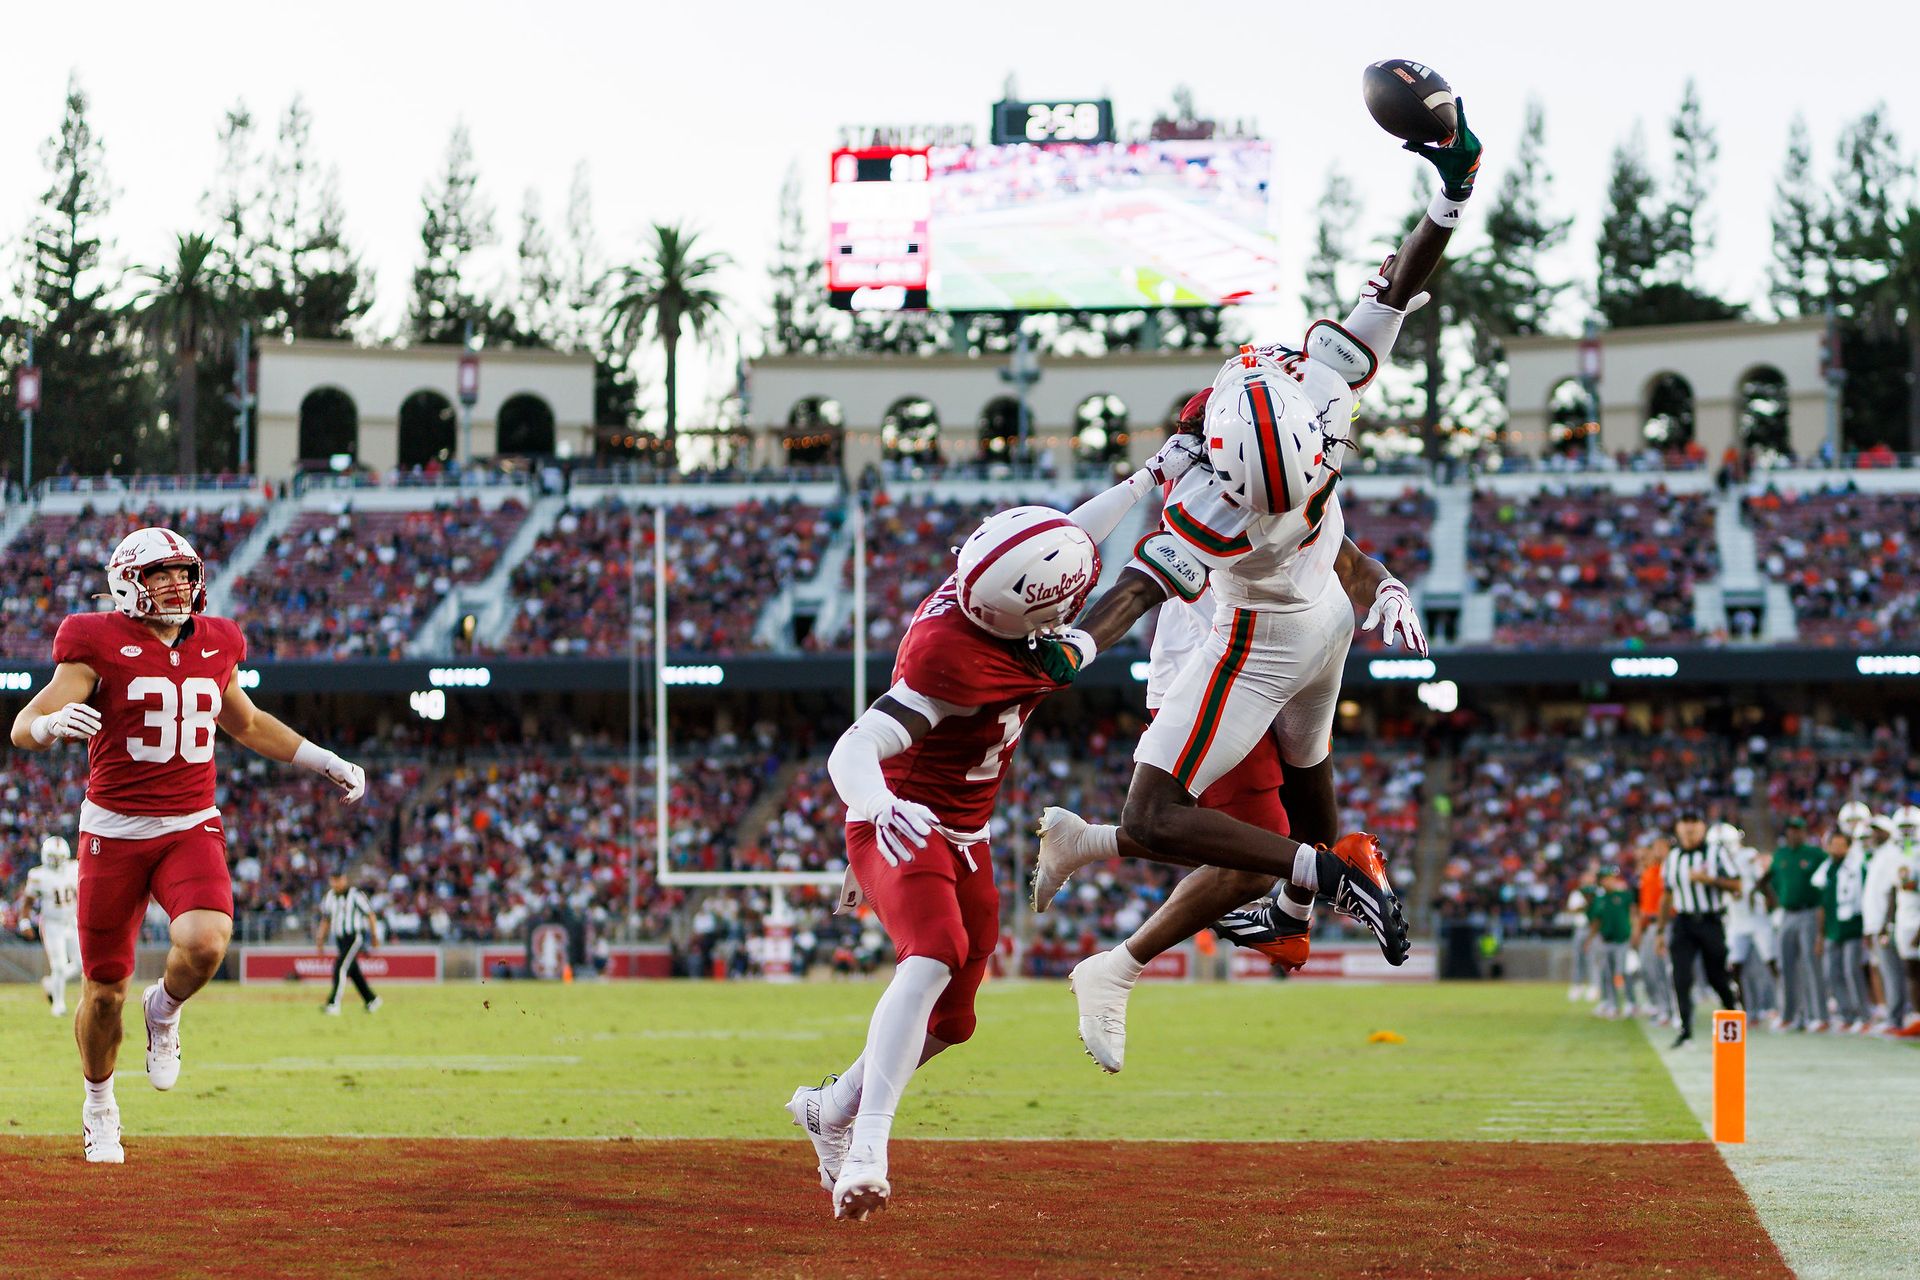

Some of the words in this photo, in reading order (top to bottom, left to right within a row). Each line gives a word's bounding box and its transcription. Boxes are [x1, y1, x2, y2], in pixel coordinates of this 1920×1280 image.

[836, 123, 976, 147] STANFORD
[1025, 560, 1086, 606] Stanford
[127, 677, 222, 763] 38
[807, 1099, 821, 1135] NIKE
